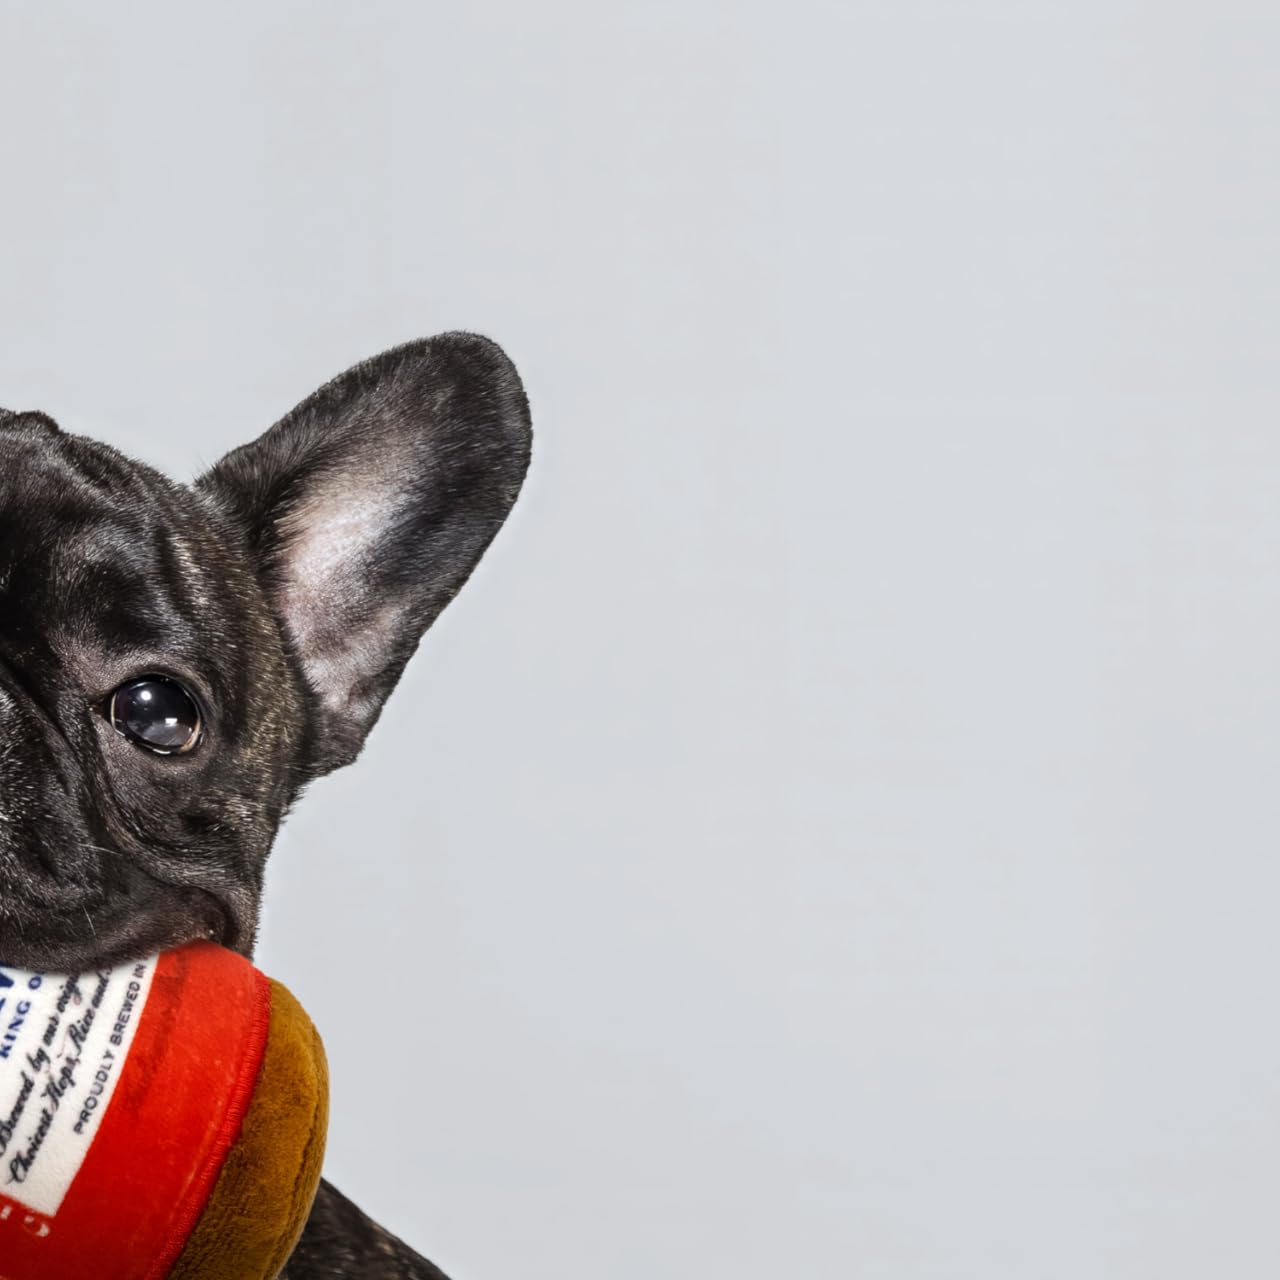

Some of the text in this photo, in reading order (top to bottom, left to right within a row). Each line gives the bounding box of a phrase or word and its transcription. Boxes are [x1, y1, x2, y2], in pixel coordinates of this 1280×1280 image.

[6, 1110, 54, 1184] Choicest
[63, 1008, 95, 1058] Rice
[91, 970, 111, 1009] and
[26, 1047, 52, 1073] by
[42, 1015, 61, 1047] our
[73, 964, 147, 1135] PROUDLY BREWED IN
